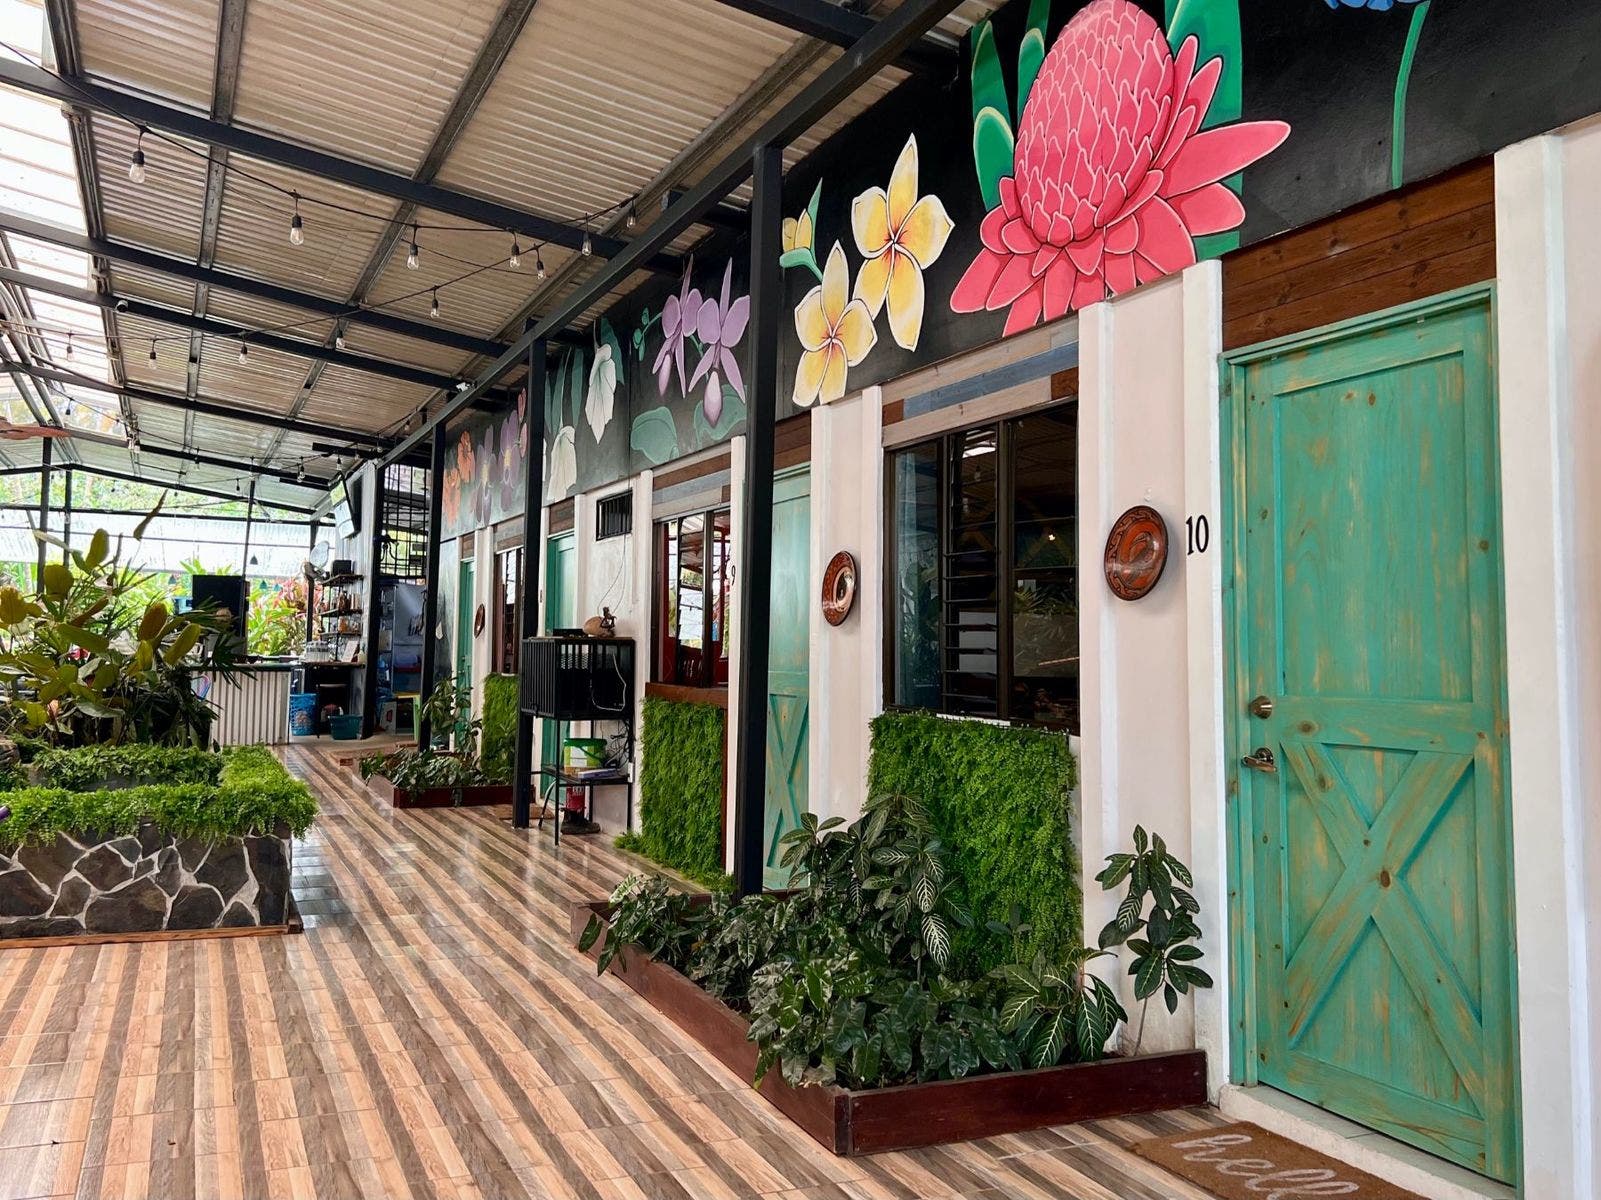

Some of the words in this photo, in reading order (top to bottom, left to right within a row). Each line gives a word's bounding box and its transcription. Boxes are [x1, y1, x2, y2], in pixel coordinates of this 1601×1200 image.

[1185, 514, 1210, 555] 10
[731, 564, 736, 586] 9
[1171, 1134, 1359, 1200] hell
